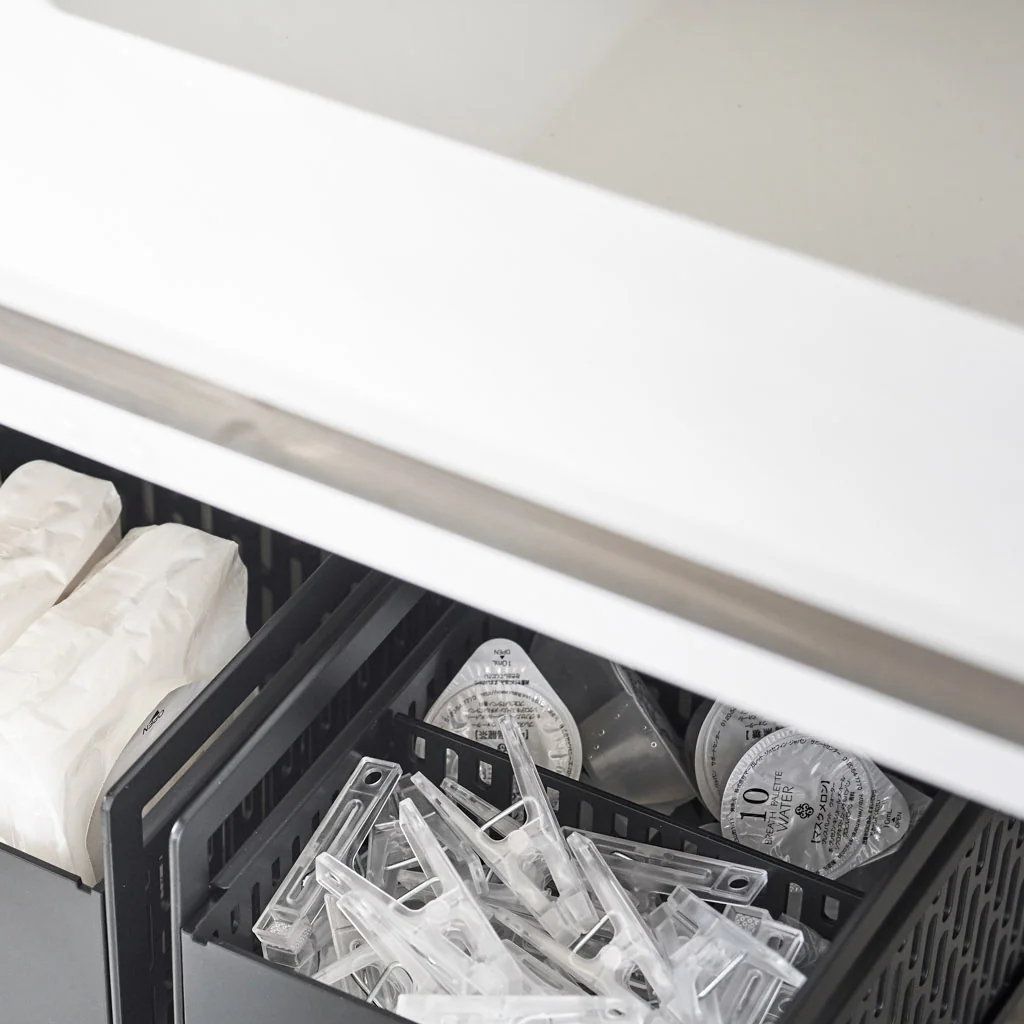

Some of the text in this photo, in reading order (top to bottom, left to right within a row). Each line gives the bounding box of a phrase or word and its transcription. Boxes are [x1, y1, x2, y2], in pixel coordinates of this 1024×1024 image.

[740, 788, 769, 821] 10
[764, 771, 783, 845] BREATH PALETTE
[776, 785, 795, 832] WATER
[811, 780, 830, 843] 【マスクメロン】
[884, 809, 893, 828] 10mL
